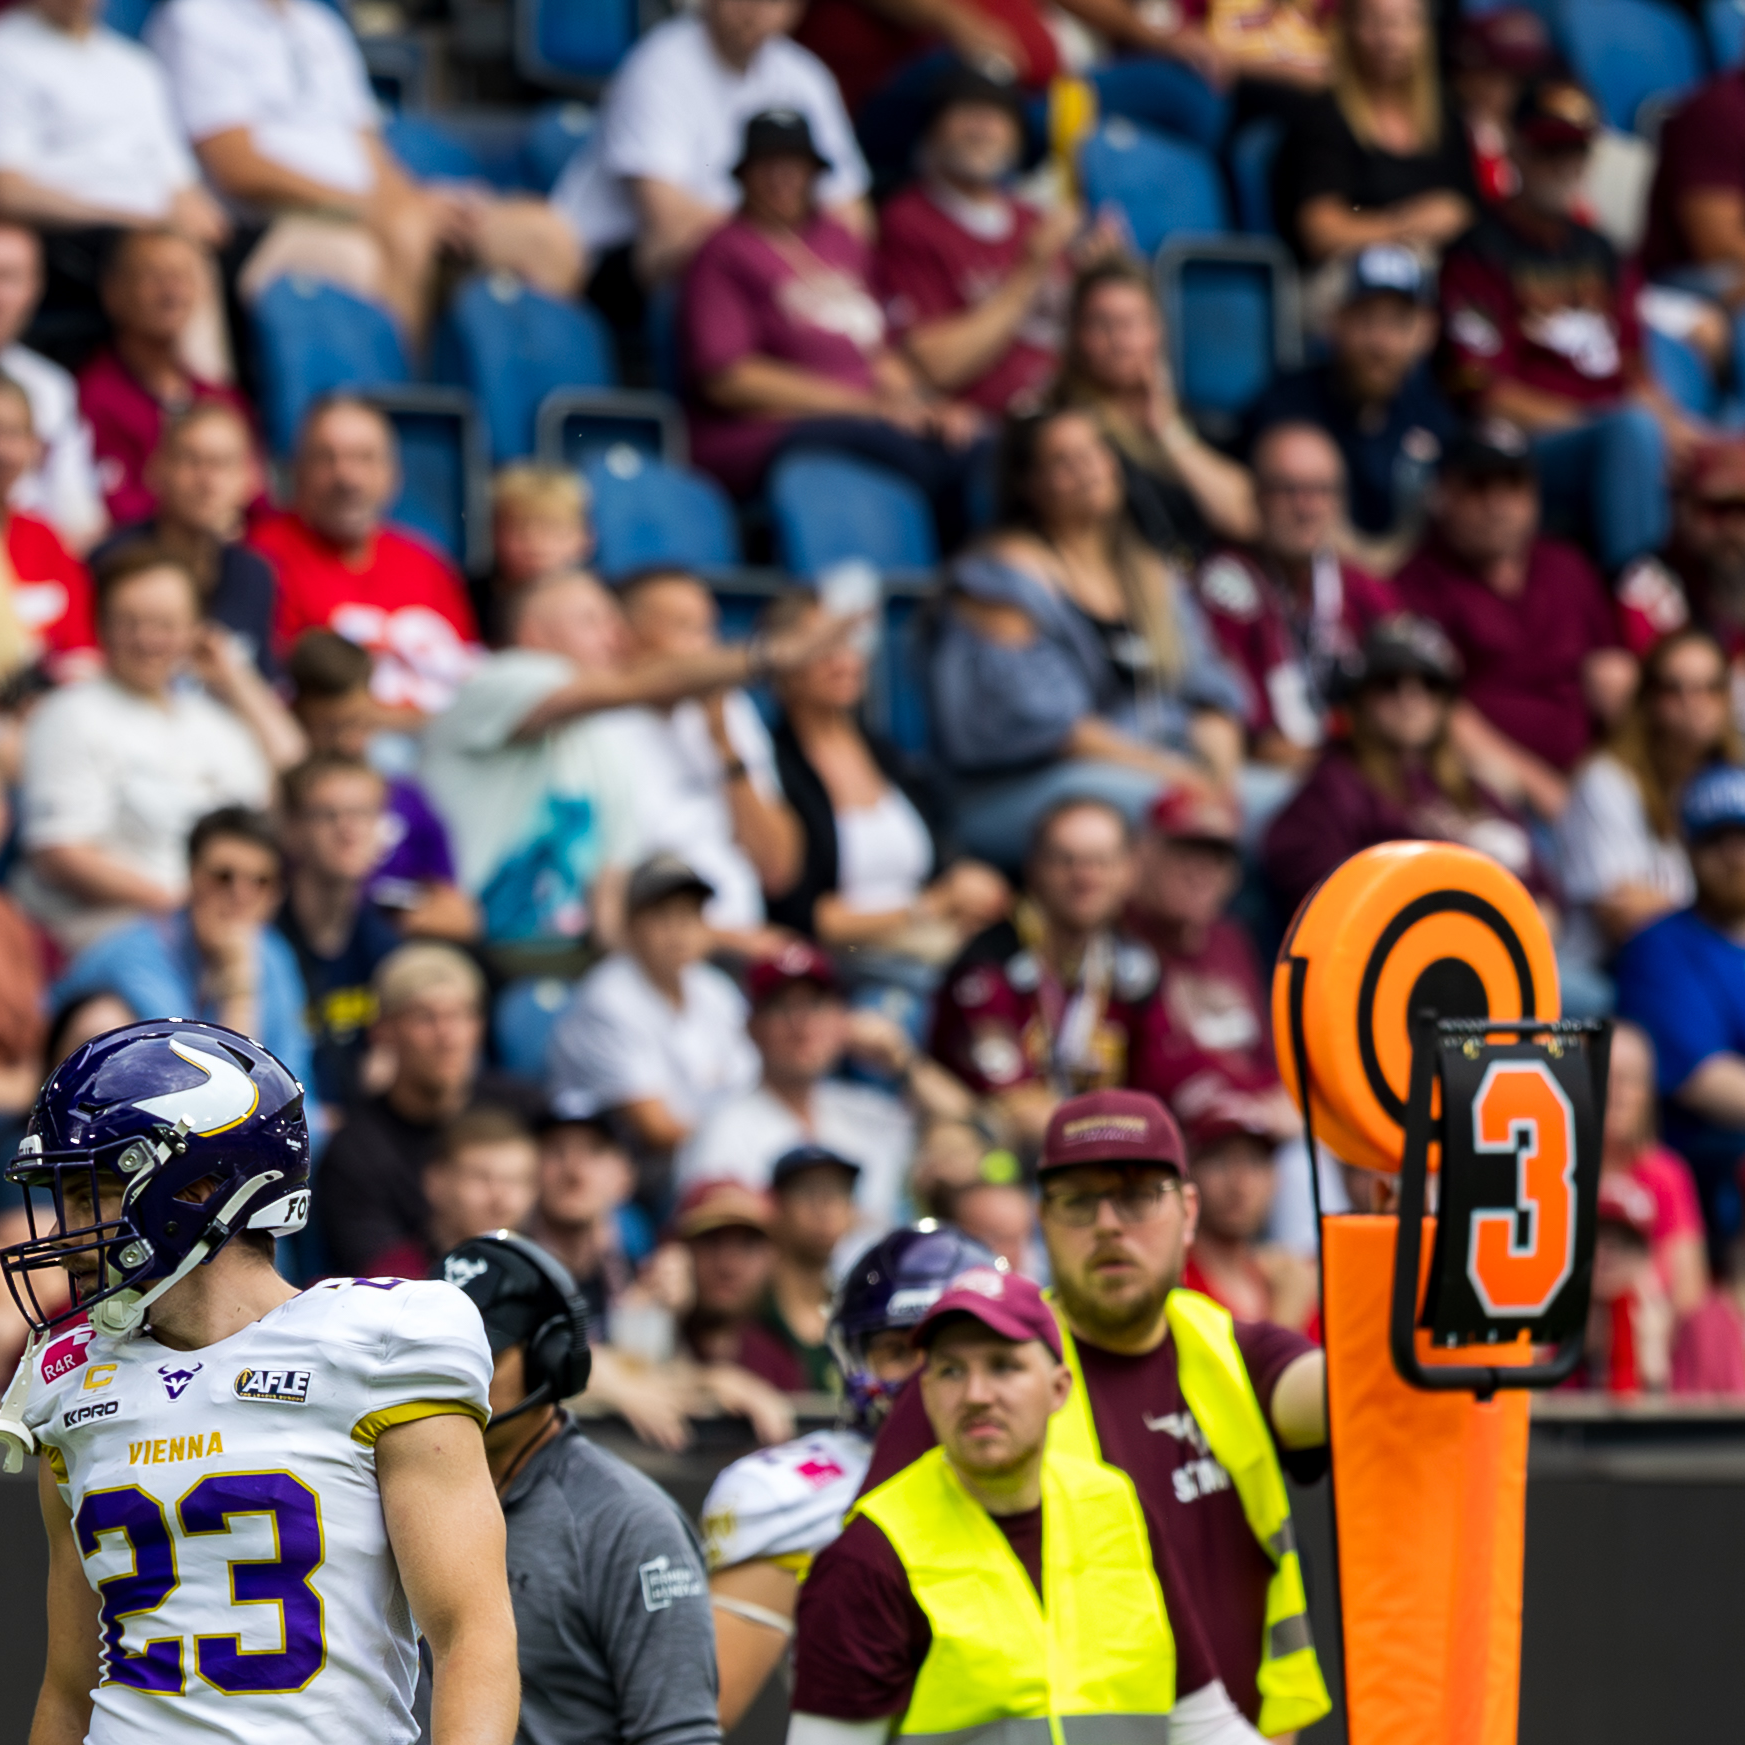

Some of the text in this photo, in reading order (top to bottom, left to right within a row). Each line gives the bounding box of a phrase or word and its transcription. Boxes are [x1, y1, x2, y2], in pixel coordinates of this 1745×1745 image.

[1467, 1058, 1577, 1318] 3
[284, 1195, 309, 1223] FO
[44, 1354, 76, 1381] R4R
[83, 1364, 117, 1390] C
[242, 1371, 310, 1396] AFLE
[128, 1432, 224, 1466] VIENNA
[75, 1468, 328, 1698] 23
